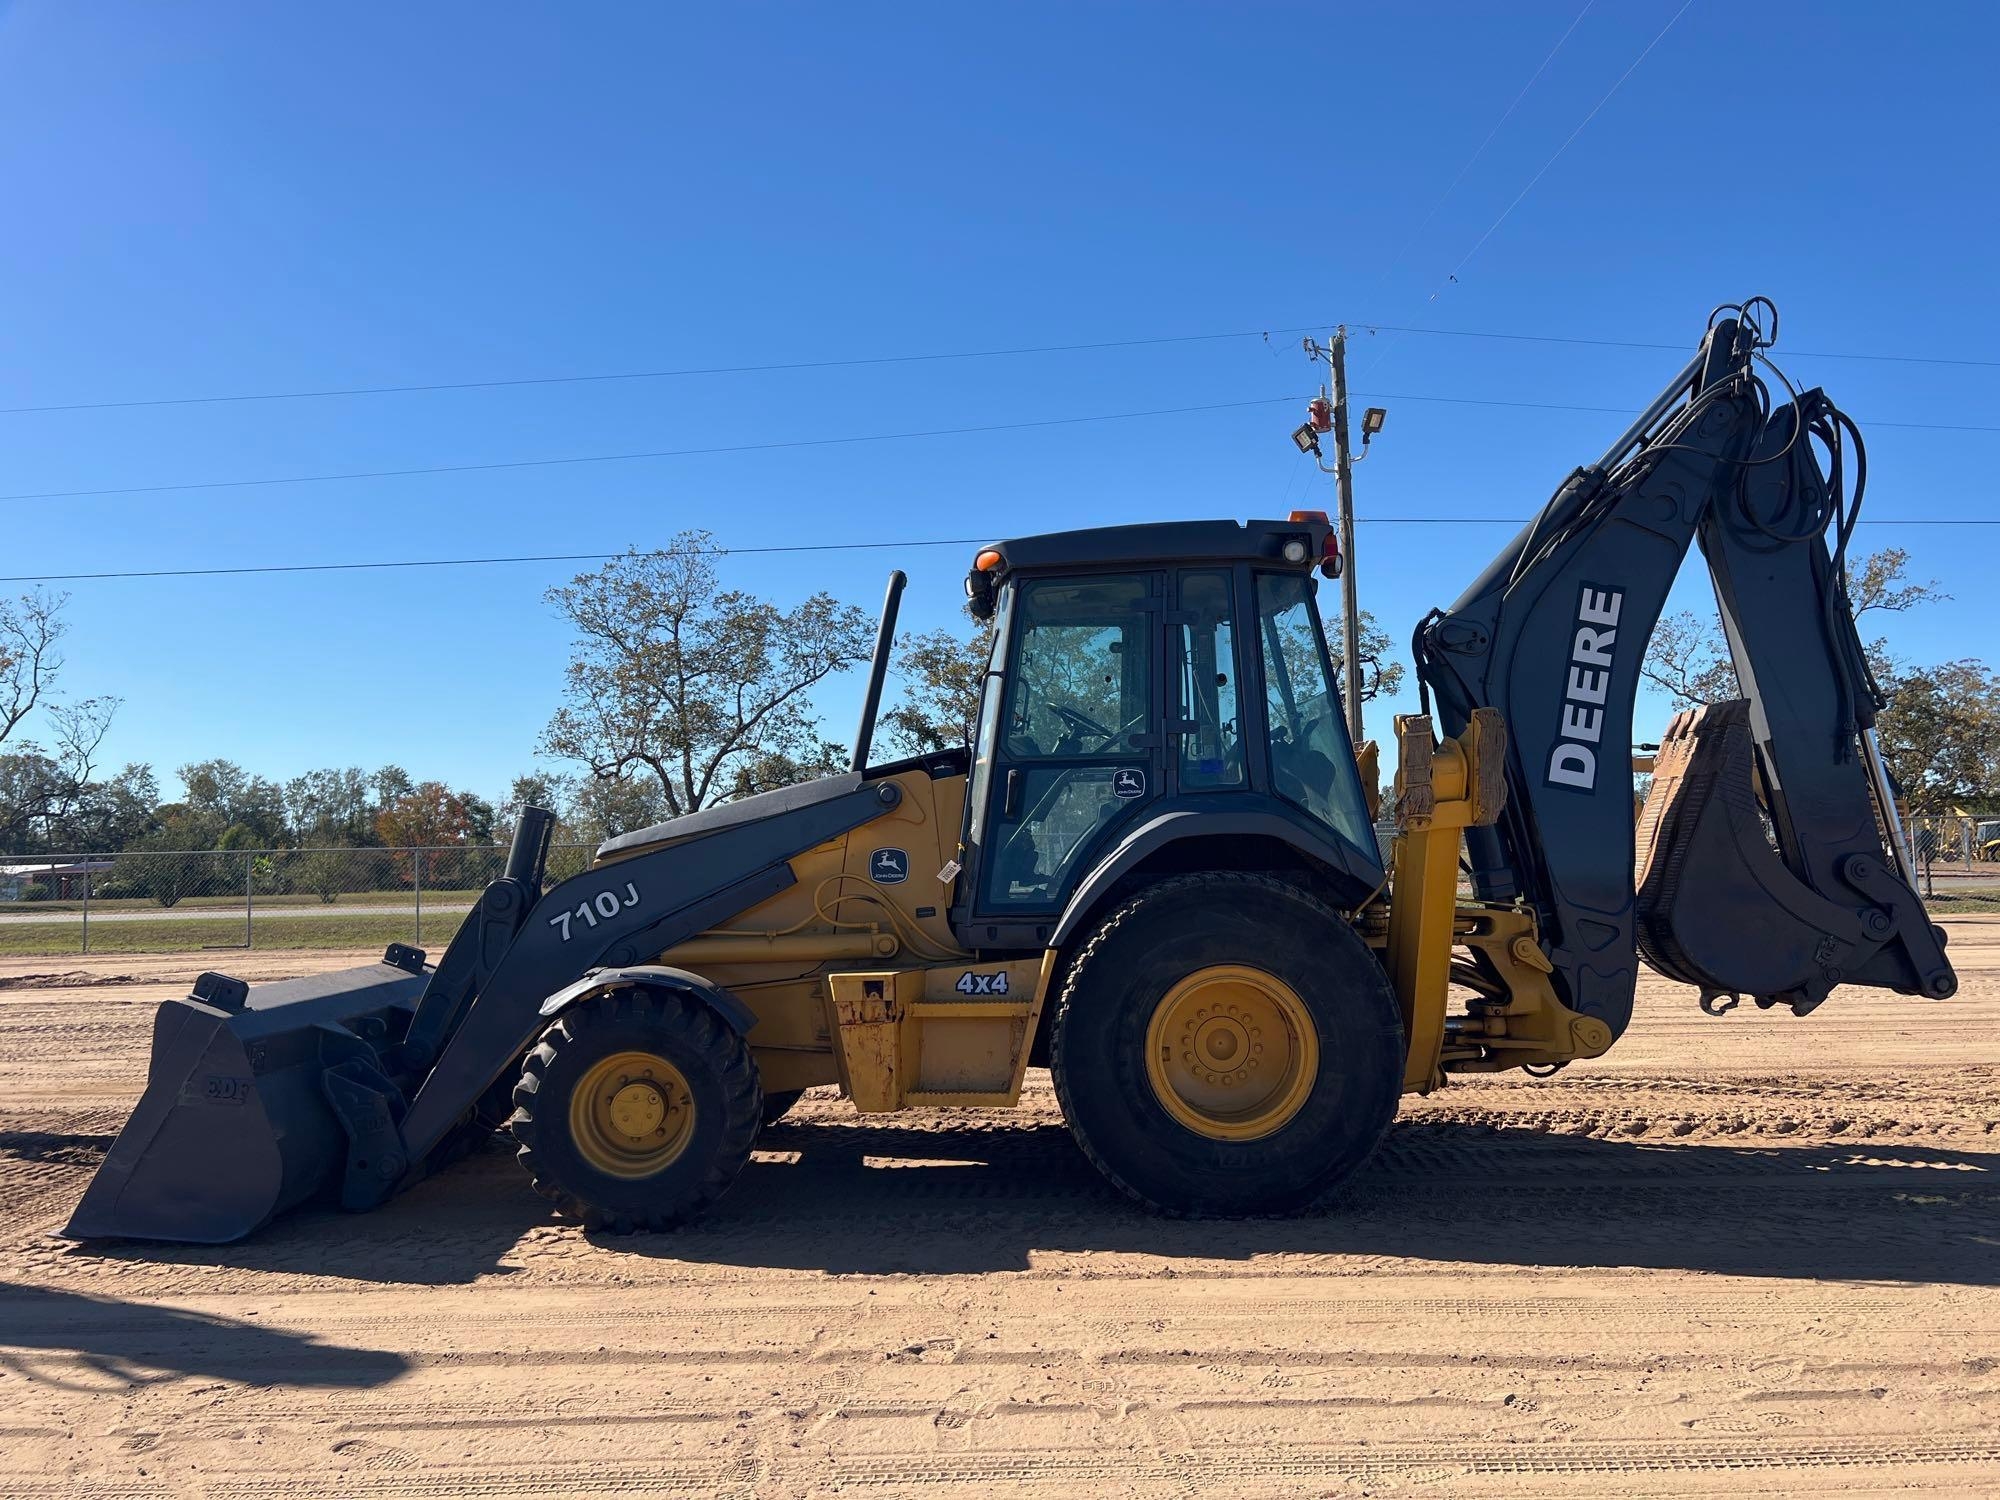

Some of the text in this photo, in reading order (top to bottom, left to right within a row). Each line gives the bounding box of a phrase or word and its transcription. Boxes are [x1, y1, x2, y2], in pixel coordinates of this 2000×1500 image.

[1548, 587, 1623, 790] DEERE
[549, 882, 640, 941] 710J
[956, 971, 1008, 994] 4x4
